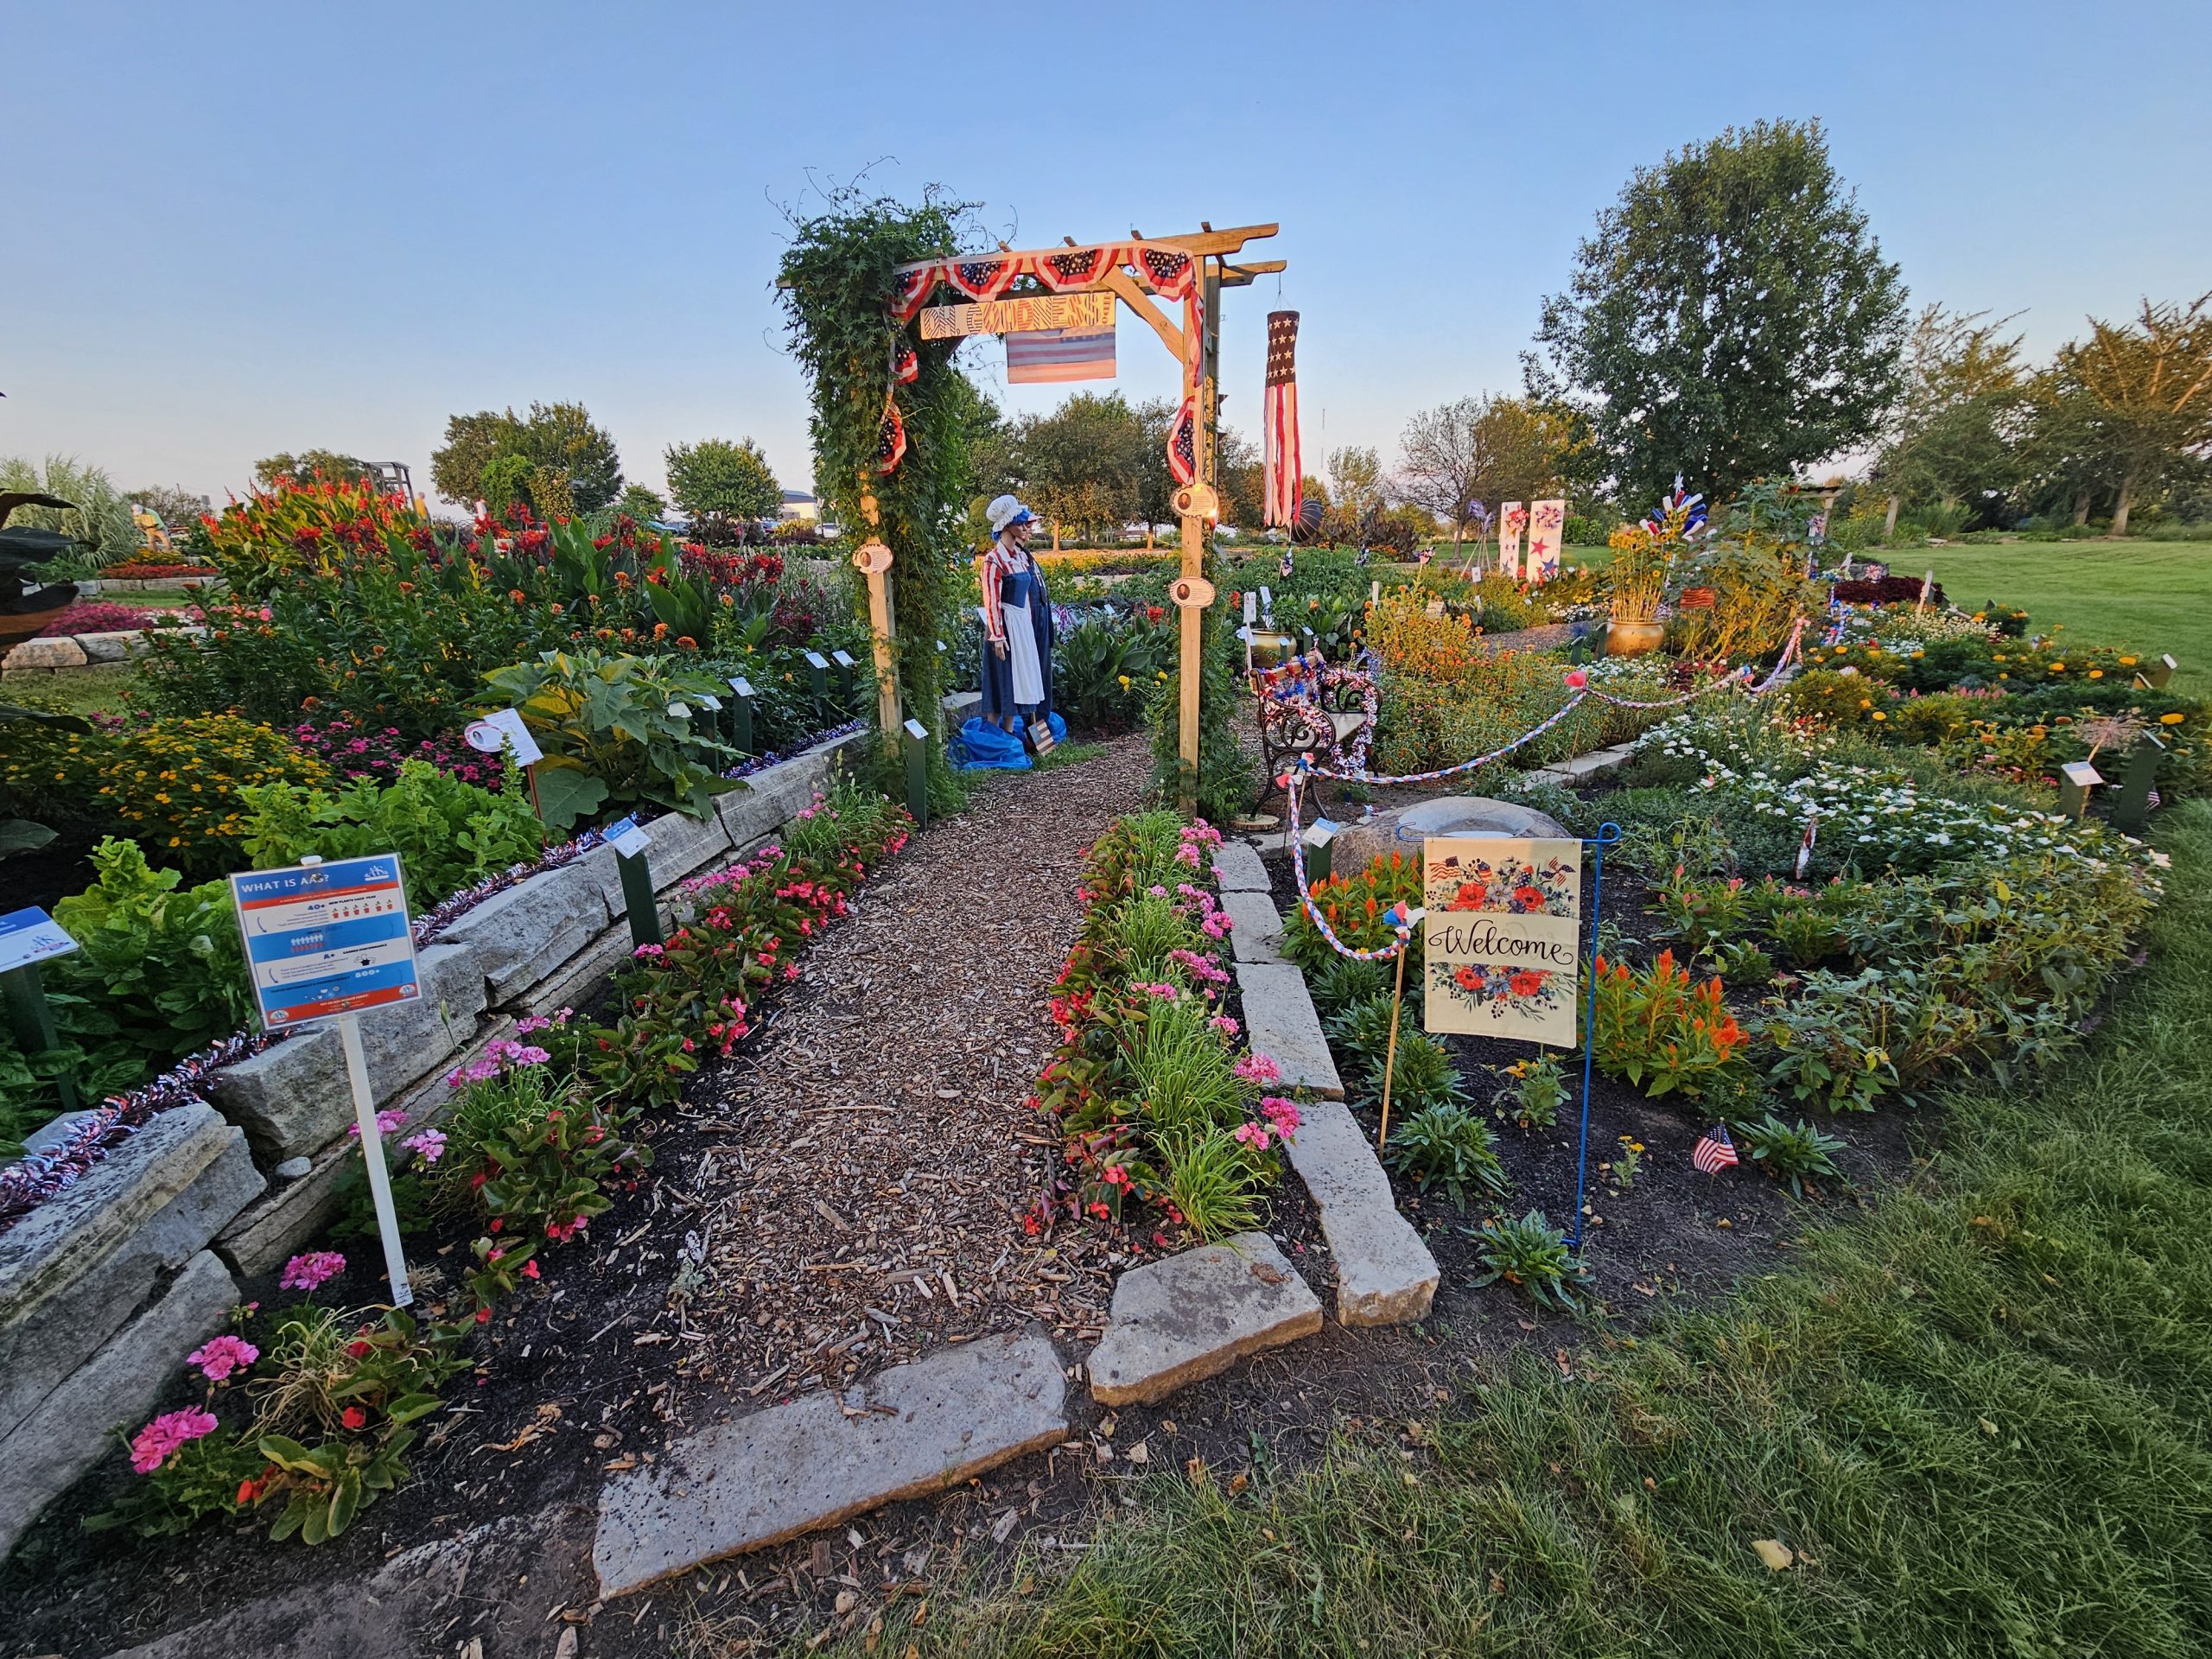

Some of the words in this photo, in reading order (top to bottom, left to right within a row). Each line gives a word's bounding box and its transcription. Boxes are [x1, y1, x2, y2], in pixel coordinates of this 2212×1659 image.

[924, 305, 961, 338] OH,
[967, 292, 1112, 335] GOODNESS!
[241, 880, 280, 893] WHAT
[284, 879, 296, 887] IS
[1428, 919, 1574, 965] Welcome
